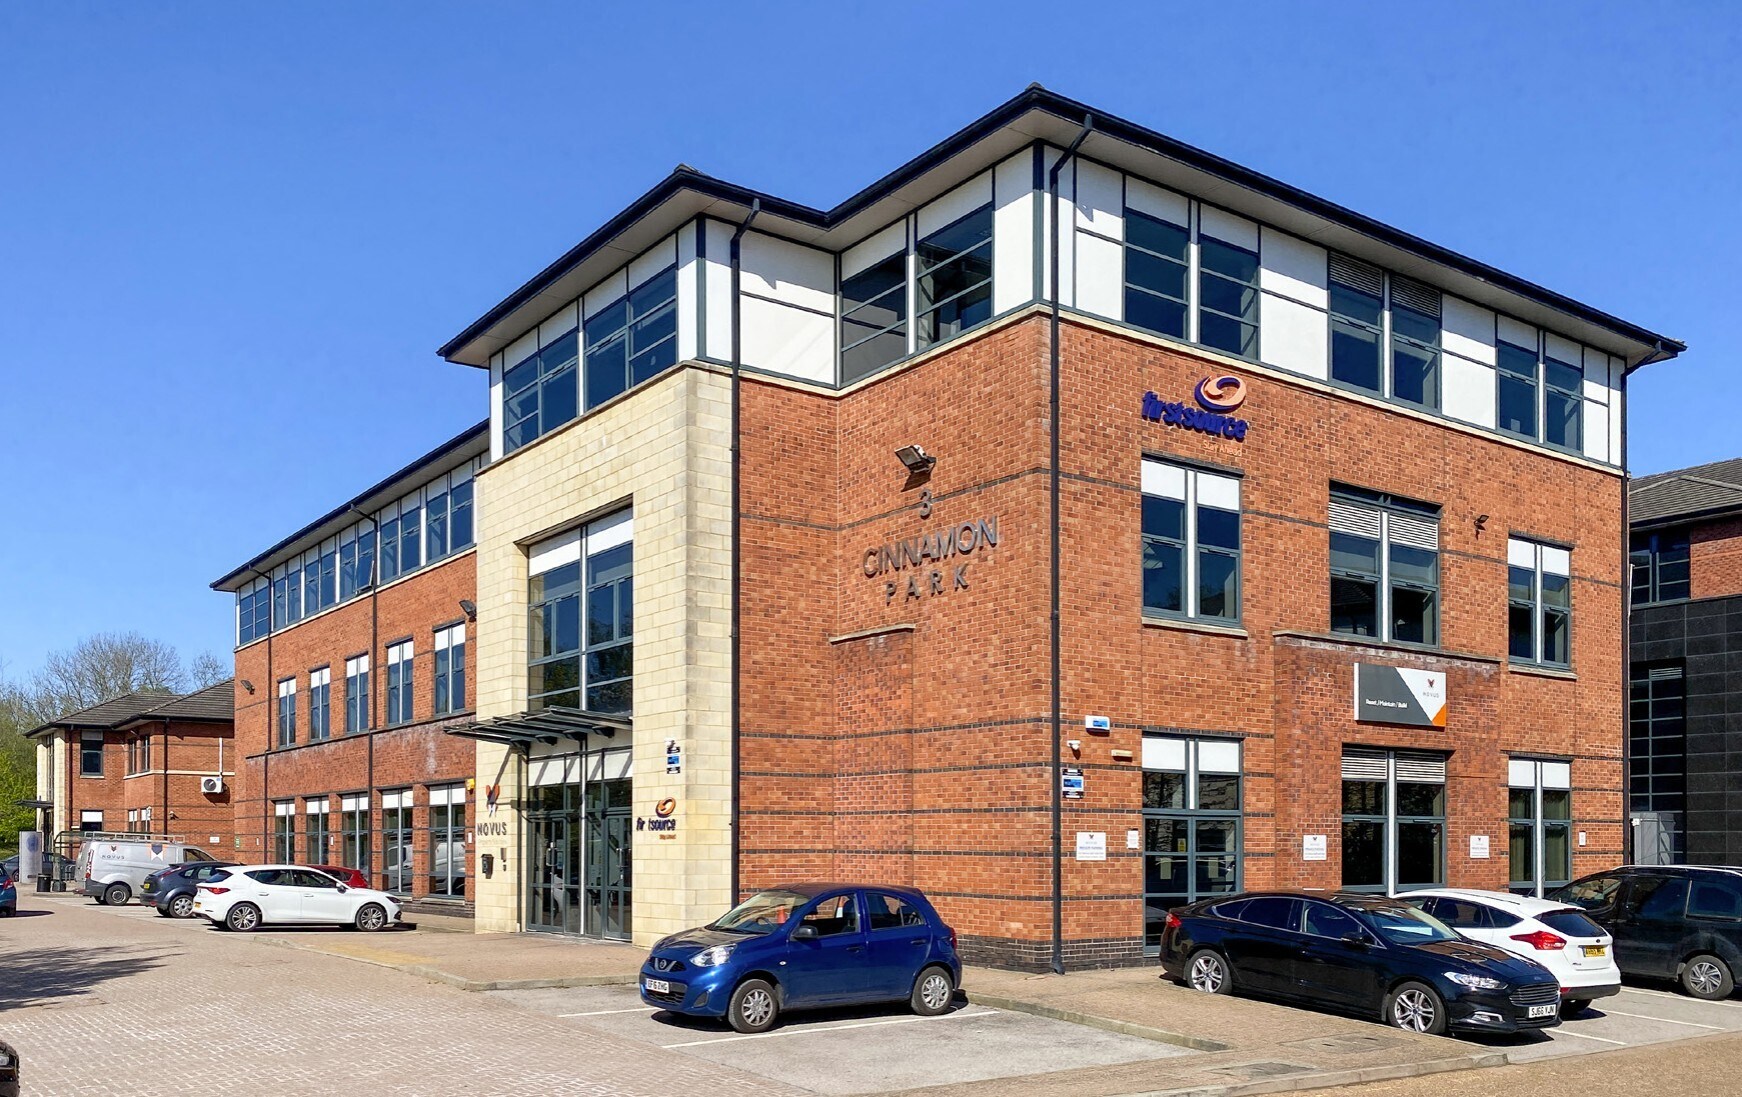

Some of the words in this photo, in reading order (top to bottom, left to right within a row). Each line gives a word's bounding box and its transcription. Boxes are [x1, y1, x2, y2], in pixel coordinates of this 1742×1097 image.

[1142, 391, 1248, 442] firstsource
[919, 488, 932, 520] 3
[863, 515, 997, 579] CINNAMON
[886, 561, 969, 606] PARK
[477, 822, 507, 836] NOVUS
